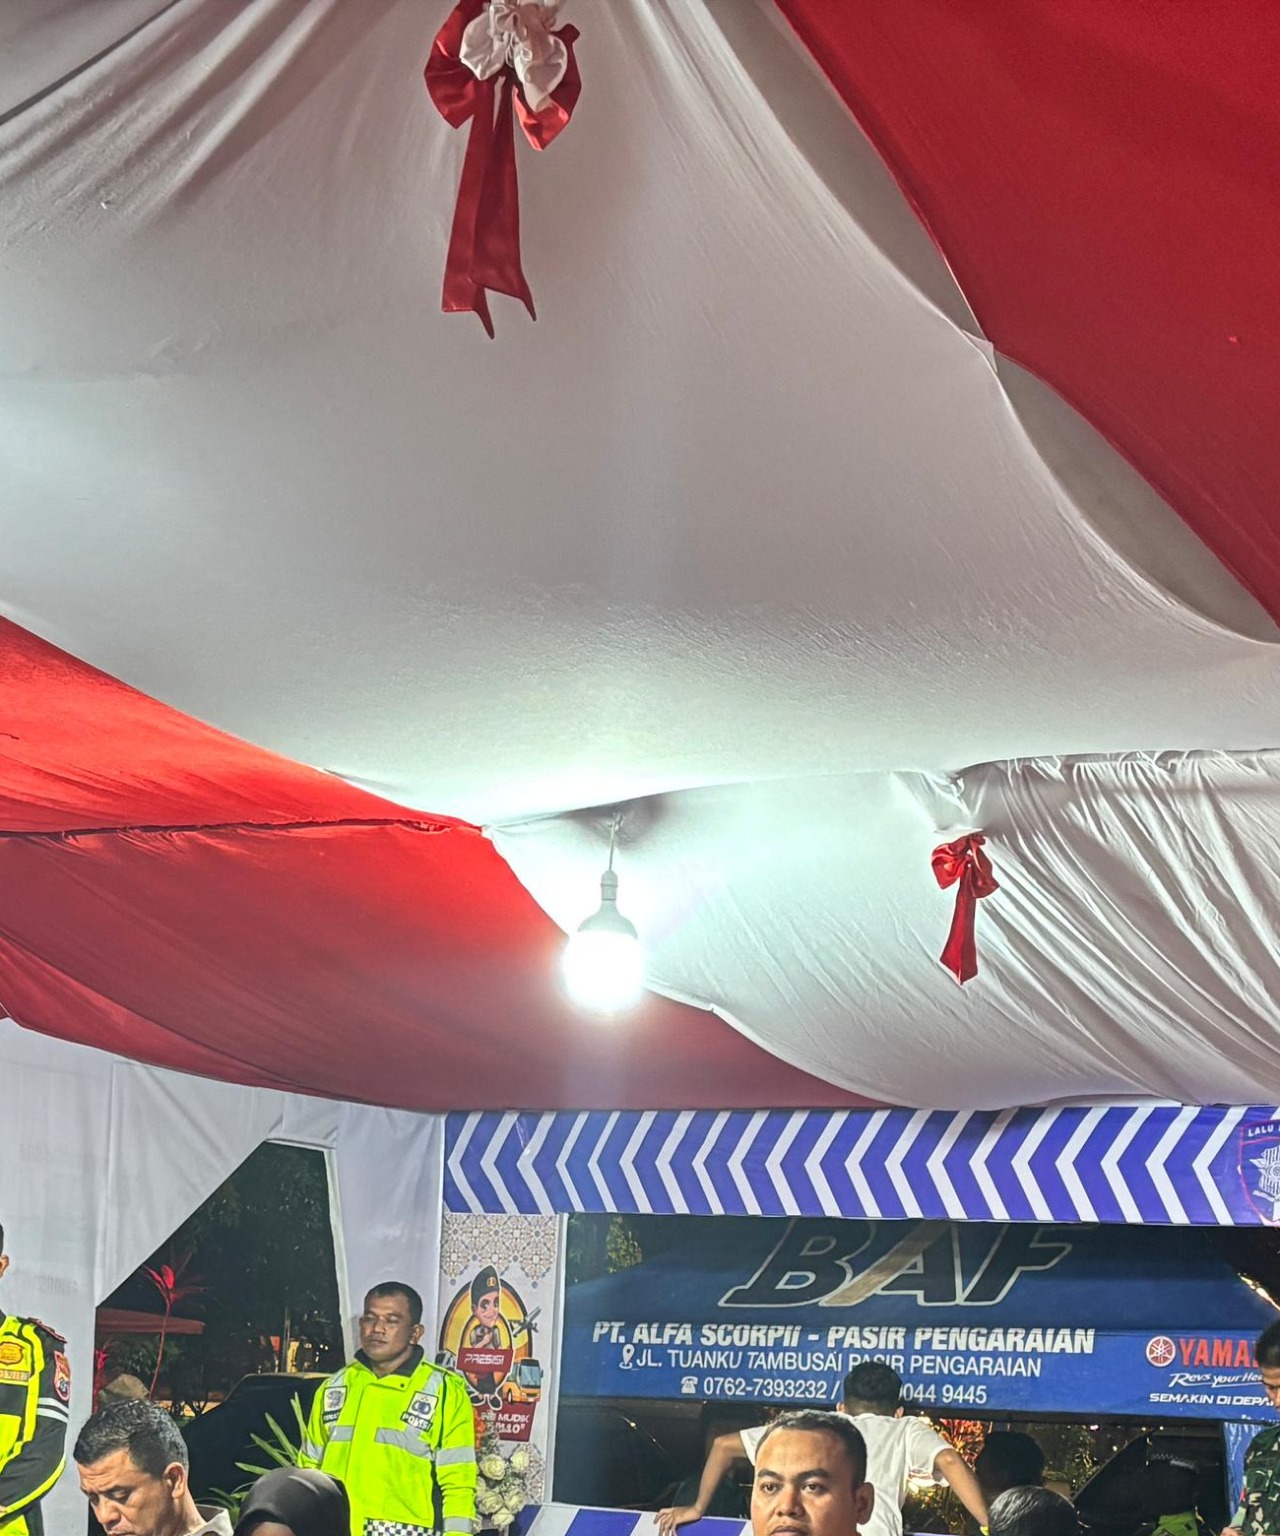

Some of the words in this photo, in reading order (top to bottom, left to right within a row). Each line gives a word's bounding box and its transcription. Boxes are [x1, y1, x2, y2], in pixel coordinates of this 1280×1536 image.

[1248, 1125, 1273, 1137] LALU
[718, 1218, 1099, 1307] BAF
[593, 1322, 625, 1344] PT.
[632, 1324, 692, 1345] ALFA
[827, 1327, 906, 1351] PASIR
[913, 1328, 1095, 1354] PENGARAIAN
[636, 1350, 662, 1368] JL.
[668, 1351, 741, 1370] TUANKU
[747, 1351, 842, 1373] TAMBUSAI
[910, 1356, 1040, 1377] PENGARAIAN
[703, 1377, 827, 1399] 0762-7393232
[900, 1384, 936, 1403] 044
[942, 1385, 987, 1404] 9445
[1169, 1372, 1211, 1387] Revs
[1212, 1374, 1240, 1387] your
